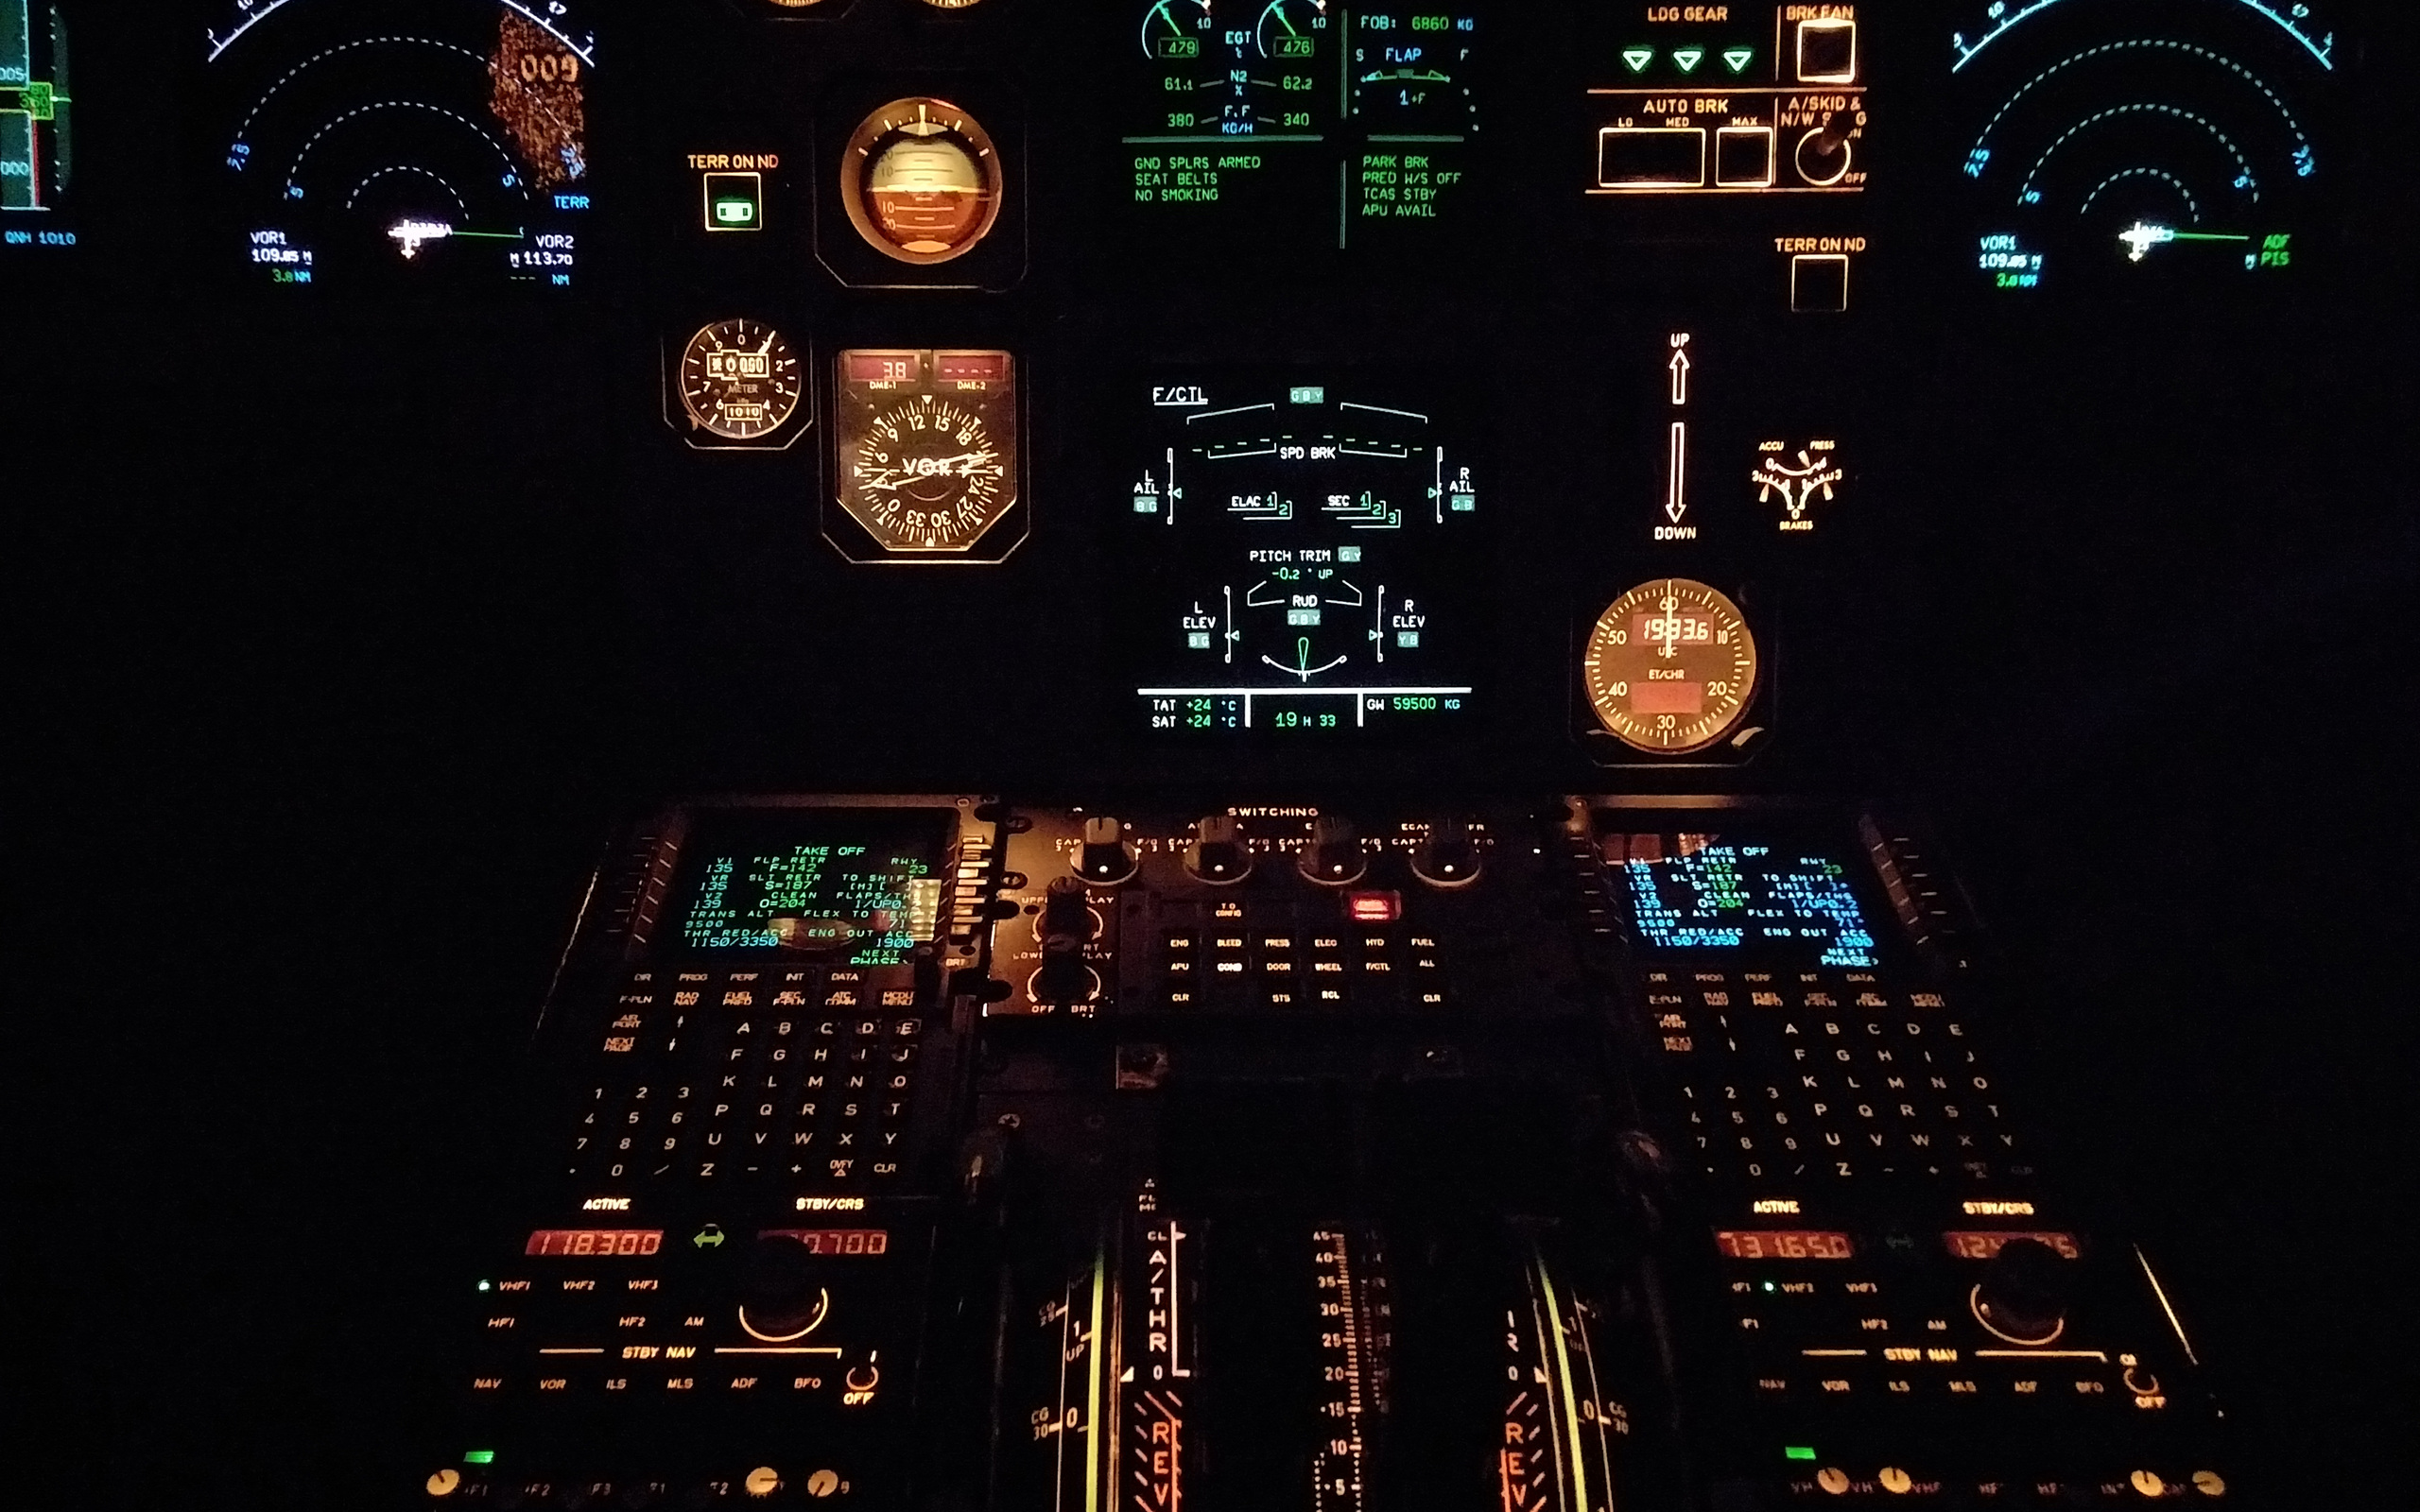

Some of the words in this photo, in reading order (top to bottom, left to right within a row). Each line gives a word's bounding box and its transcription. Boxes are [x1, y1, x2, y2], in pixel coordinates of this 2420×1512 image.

[1648, 7, 1679, 22] LDG
[1685, 7, 1727, 22] GEAR
[1787, 6, 1817, 19] BRK
[1361, 15, 1395, 29] FOB:
[1412, 16, 1448, 30] 6860
[1226, 31, 1251, 44] EGT
[1386, 47, 1421, 62] FLAP
[1165, 77, 1192, 90] 61.1
[1231, 70, 1247, 82] N2
[1284, 76, 1312, 90] 62.2
[1644, 99, 1687, 113] AUTO
[1695, 98, 1728, 113] BRK
[1168, 113, 1194, 127] 380
[1284, 112, 1309, 126] 340
[1666, 117, 1689, 127] MED
[1732, 117, 1757, 127] MAX
[688, 155, 729, 168] TERR
[733, 155, 753, 168] ON
[757, 155, 778, 168] ND
[1135, 157, 1160, 169] GND
[1169, 157, 1209, 169] SPLRS
[1219, 156, 1260, 168] ARMED
[1363, 156, 1396, 167] PARK
[1405, 156, 1428, 168] BRK
[1136, 173, 1167, 185] SEAT
[1178, 172, 1217, 185] BELTS
[1363, 171, 1396, 184] PRED
[1437, 173, 1461, 184] OFF
[1135, 189, 1152, 201] NO
[1162, 188, 1218, 201] SMOKING
[1364, 187, 1395, 200] TCAS
[1404, 188, 1436, 200] STBY
[554, 196, 589, 209] TERR
[1362, 204, 1387, 215] APU
[1396, 204, 1435, 216] AVAIL
[39, 232, 76, 245] 1010
[251, 231, 286, 245] VOR1
[536, 234, 574, 249] VOR2
[1774, 238, 1817, 252] TERR
[1820, 237, 1841, 251] ON
[1844, 237, 1865, 251] ND
[524, 251, 573, 265] 113.70
[1670, 334, 1689, 348] UP
[1153, 387, 1208, 402] F/CTL
[908, 416, 925, 431] 12
[935, 415, 949, 431] 15
[955, 427, 972, 446] 18
[1759, 441, 1784, 451] ACCU
[1280, 447, 1305, 459] SPD
[1311, 447, 1336, 459] BRK
[1134, 483, 1159, 495] AIL
[1449, 480, 1475, 492] AIL
[1232, 496, 1261, 507] ELAC
[1328, 495, 1350, 507] SEC
[1654, 526, 1696, 540] DOWN
[1250, 550, 1291, 562] PITCH
[1300, 550, 1330, 561] TRIM
[1319, 569, 1333, 579] UP
[1293, 594, 1318, 607] RUD
[1184, 616, 1216, 628] ELEV
[1393, 615, 1425, 627] ELEV
[1607, 630, 1627, 644] 50
[1717, 630, 1728, 644] 10
[1649, 669, 1685, 679] ET/CHR
[1609, 682, 1627, 696] 40
[1707, 682, 1726, 696] 20
[1153, 699, 1176, 712] TAT
[1186, 699, 1211, 711] +24
[1393, 697, 1436, 710] 59500
[1445, 699, 1460, 709] KG
[1152, 715, 1176, 728] SAT
[1186, 714, 1210, 727] +24
[1275, 712, 1297, 727] 19
[1304, 716, 1311, 726] H
[1320, 714, 1336, 727] 33
[1657, 715, 1675, 730] 30
[1228, 808, 1318, 816] SWITCHING
[795, 847, 829, 855] TAKE
[838, 847, 865, 855] OFF
[1701, 847, 1734, 856] TAKE
[1743, 847, 1769, 856] OFF
[707, 864, 734, 873] 135
[908, 866, 928, 874] 23
[691, 936, 779, 947] 1150/3350
[876, 938, 913, 947] 1900
[583, 1198, 631, 1210] ACTIVE
[796, 1197, 864, 1210] STBY/CRS
[622, 1347, 659, 1359] STBY
[666, 1347, 696, 1358] NAV
[475, 1379, 501, 1388] NAV
[541, 1380, 566, 1389] VOR
[732, 1378, 757, 1388] ADF
[843, 1393, 873, 1404] OFF
